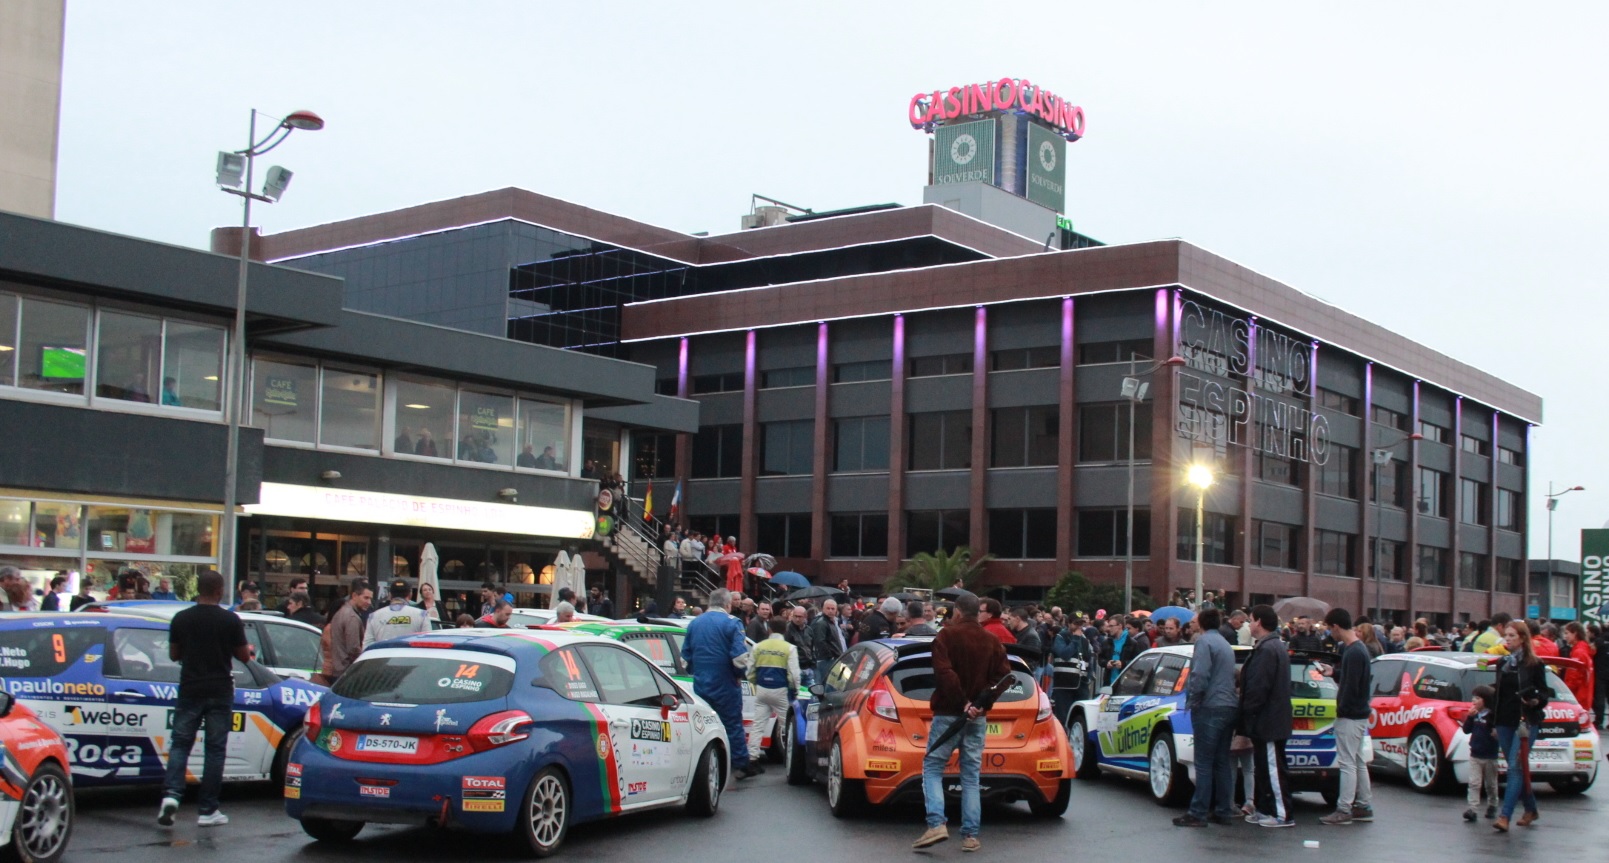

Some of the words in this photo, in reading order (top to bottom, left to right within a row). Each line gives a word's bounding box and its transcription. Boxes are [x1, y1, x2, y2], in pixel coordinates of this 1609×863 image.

[909, 77, 1017, 125] CASINO
[1019, 79, 1086, 137] CASINO
[938, 168, 988, 185] SOLVERDE
[1031, 173, 1063, 194] SOLVERDE
[1179, 301, 1309, 393] CASINO
[1174, 371, 1330, 466] ESPINHO
[412, 501, 427, 513] DE
[52, 633, 66, 663] 9
[455, 664, 480, 679] 14
[559, 650, 581, 681] 14
[453, 678, 482, 687] CASINO
[280, 686, 322, 706] BAX
[81, 708, 148, 727] weber
[671, 713, 689, 722] TOTAL
[1294, 702, 1326, 717] ate
[1380, 704, 1434, 727] vodafone
[232, 712, 242, 732] 9
[641, 720, 661, 731] CASINO
[366, 738, 416, 750] DS-570-JK
[641, 730, 661, 741] ESPINHO
[67, 738, 143, 764] Roca
[1286, 754, 1320, 766] ODA
[465, 777, 504, 788] TOTAL
